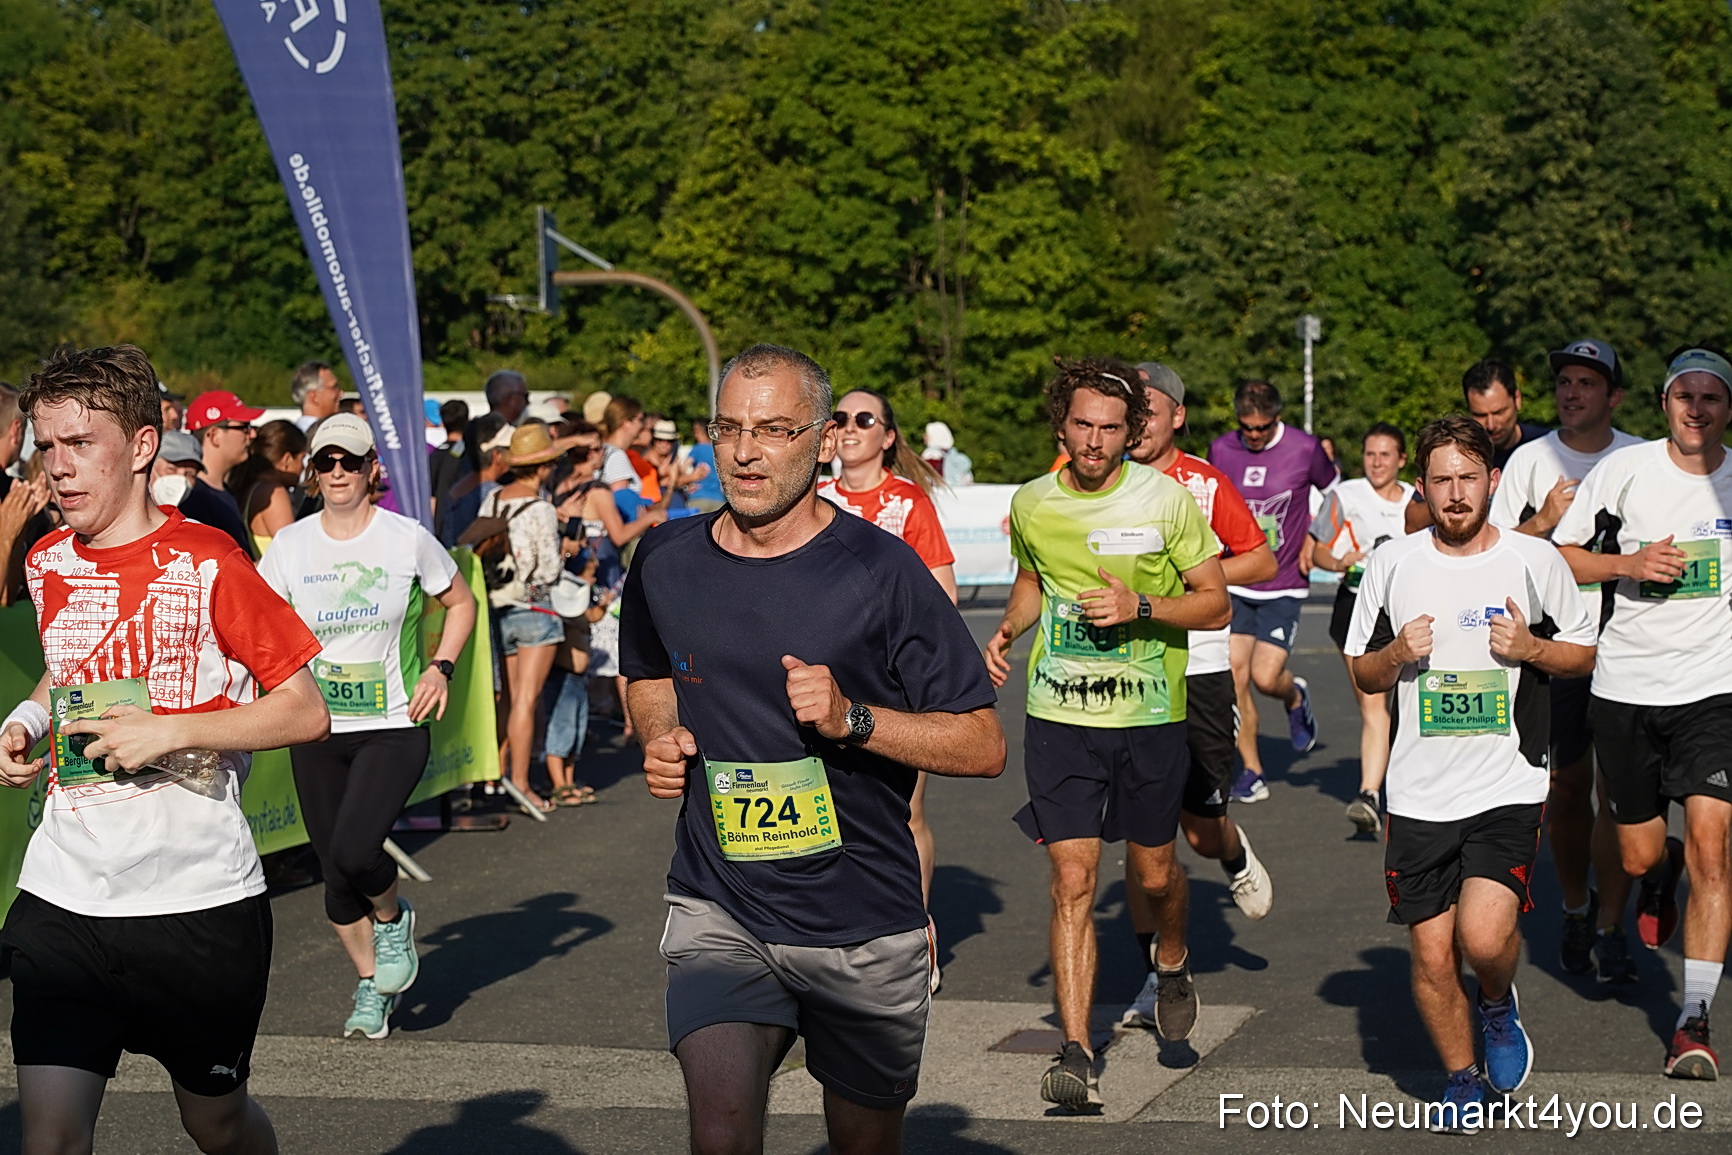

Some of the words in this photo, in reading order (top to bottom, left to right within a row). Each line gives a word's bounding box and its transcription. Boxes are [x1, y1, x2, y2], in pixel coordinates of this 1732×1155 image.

[163, 571, 199, 582] 91.62%
[304, 573, 339, 584] BERATA
[318, 603, 379, 622] Laufend
[315, 620, 389, 637] erfolgreich
[61, 638, 88, 649] 26.22
[328, 681, 364, 699] 361
[375, 683, 384, 709] 2022
[1424, 699, 1432, 722] RUN
[1441, 693, 1483, 714] 531
[1496, 694, 1506, 724] 2022
[1434, 715, 1464, 723] Stöcker
[1467, 716, 1496, 724] Philipp
[57, 733, 65, 766] RUN
[732, 780, 768, 789] Firmenlauf
[733, 796, 801, 828] 724
[814, 793, 832, 836] 2022
[715, 800, 727, 846] WALK
[727, 831, 759, 842] Böhm
[763, 825, 818, 842] Reinhold
